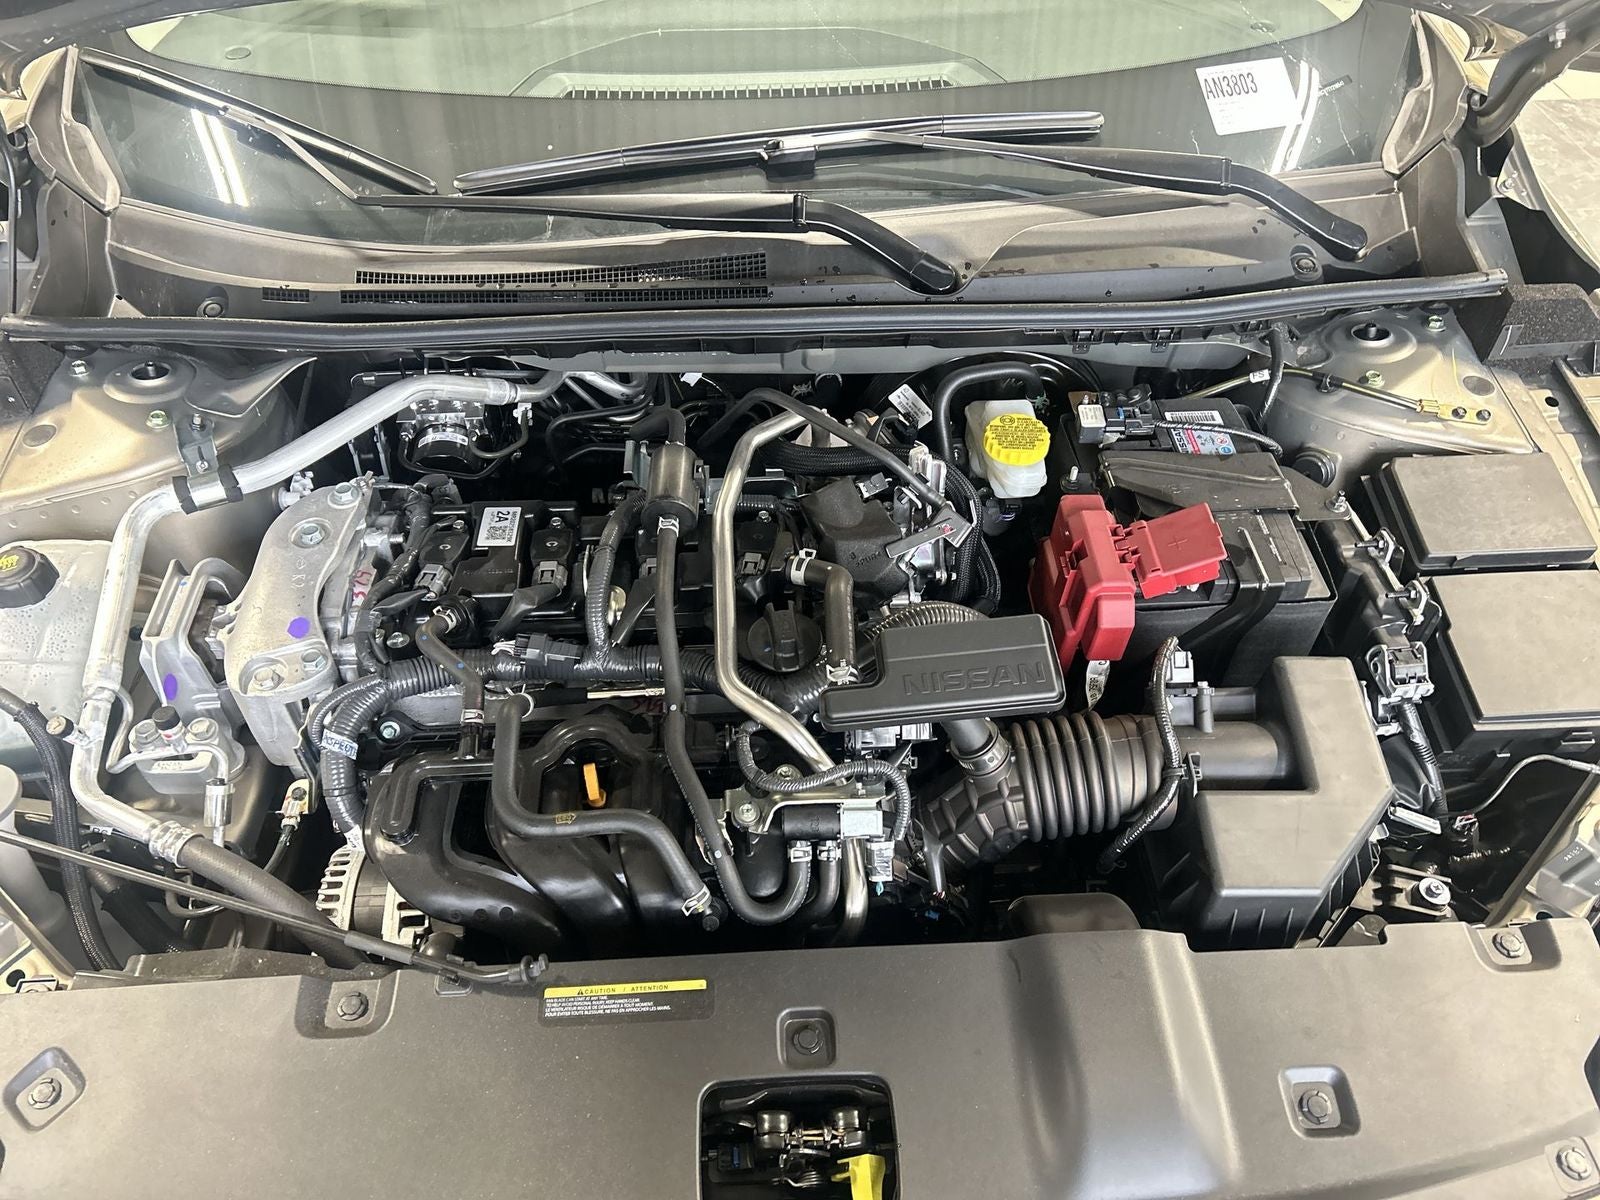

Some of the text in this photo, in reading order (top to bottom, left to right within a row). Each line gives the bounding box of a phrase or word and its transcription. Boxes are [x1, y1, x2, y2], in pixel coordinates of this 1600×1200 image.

[1203, 72, 1258, 100] AN3803
[495, 510, 511, 523] 2A
[902, 661, 1046, 696] NISSAN
[585, 987, 616, 995] CAUTION
[631, 984, 669, 993] ATTENTION
